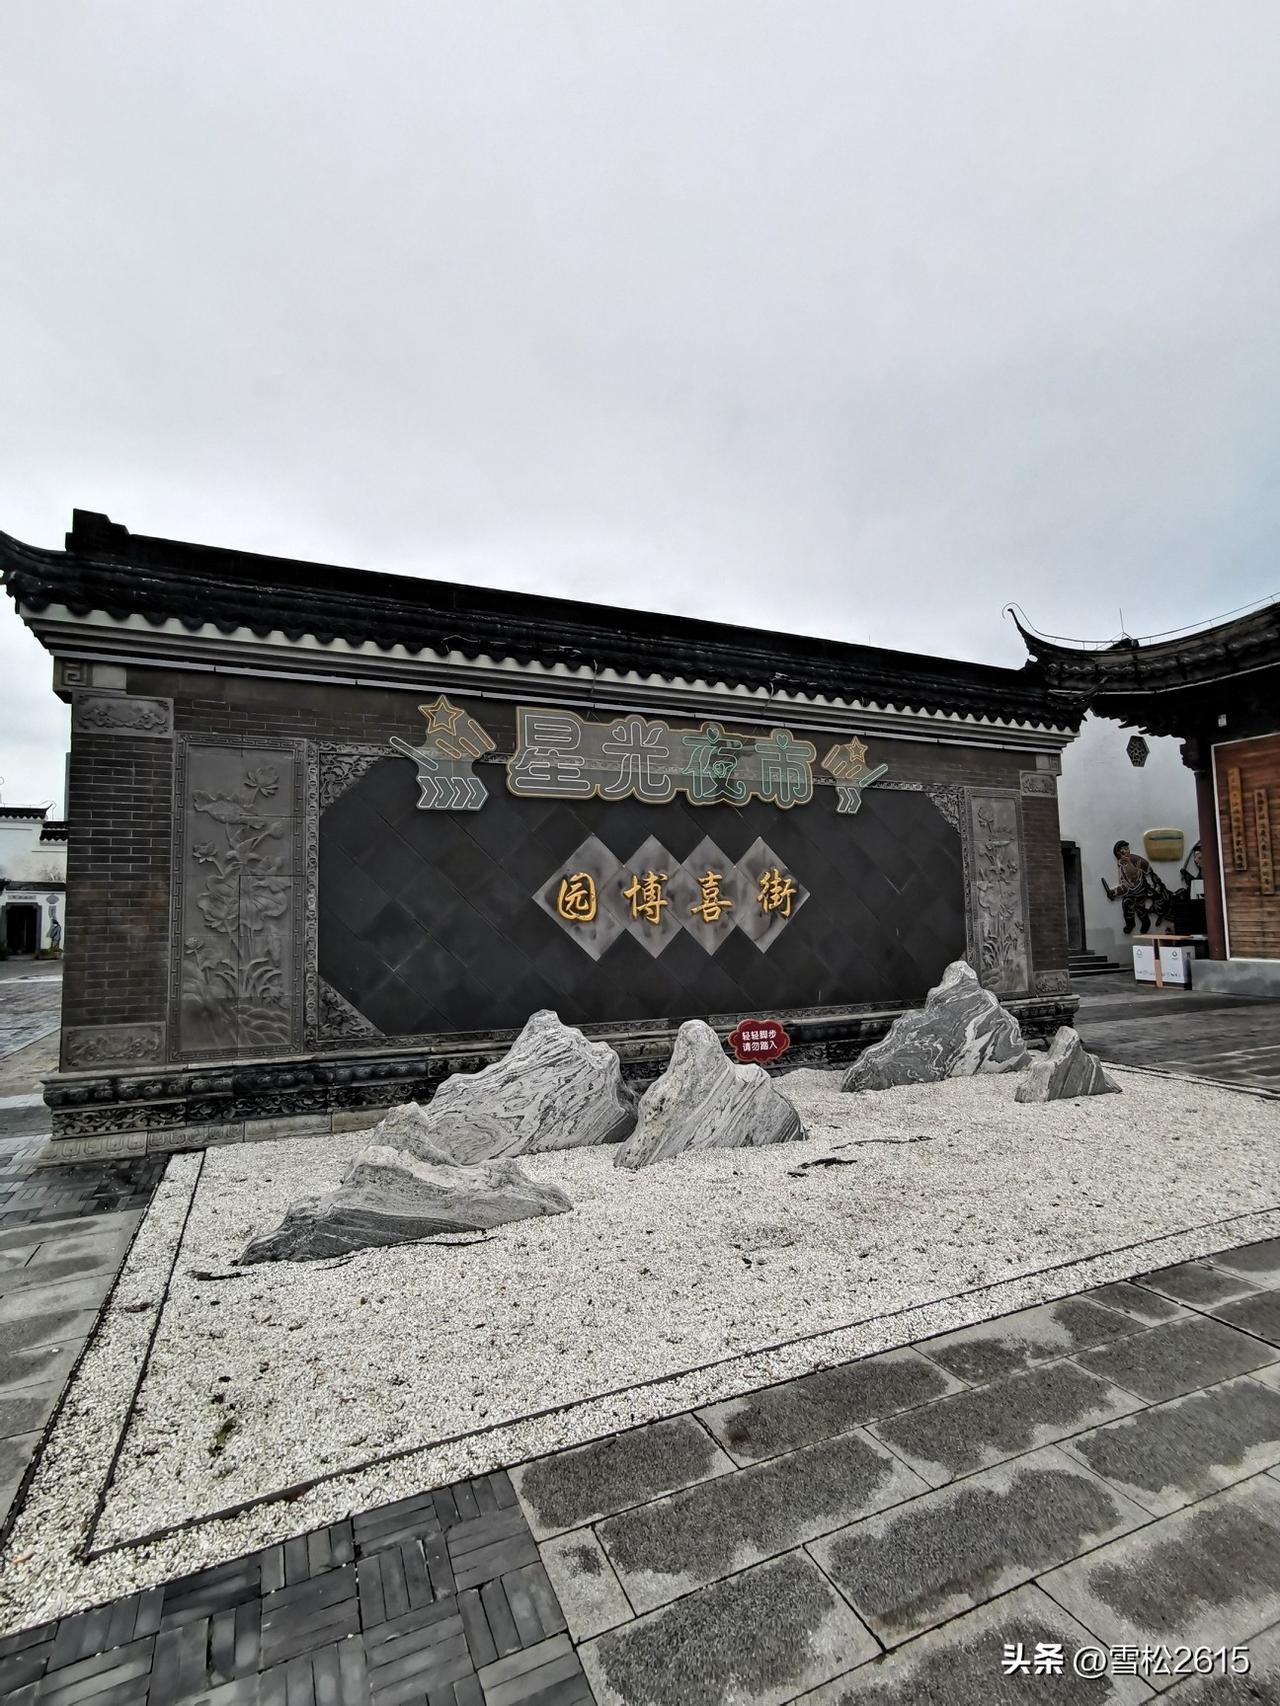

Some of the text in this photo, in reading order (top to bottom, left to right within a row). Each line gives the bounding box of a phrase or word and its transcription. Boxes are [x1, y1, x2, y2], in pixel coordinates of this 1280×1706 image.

[513, 712, 813, 802] 星光夜市
[557, 868, 798, 925] 园博喜街
[742, 1030, 777, 1040] 轻轻脚步
[742, 1041, 778, 1052] 请勿踏入
